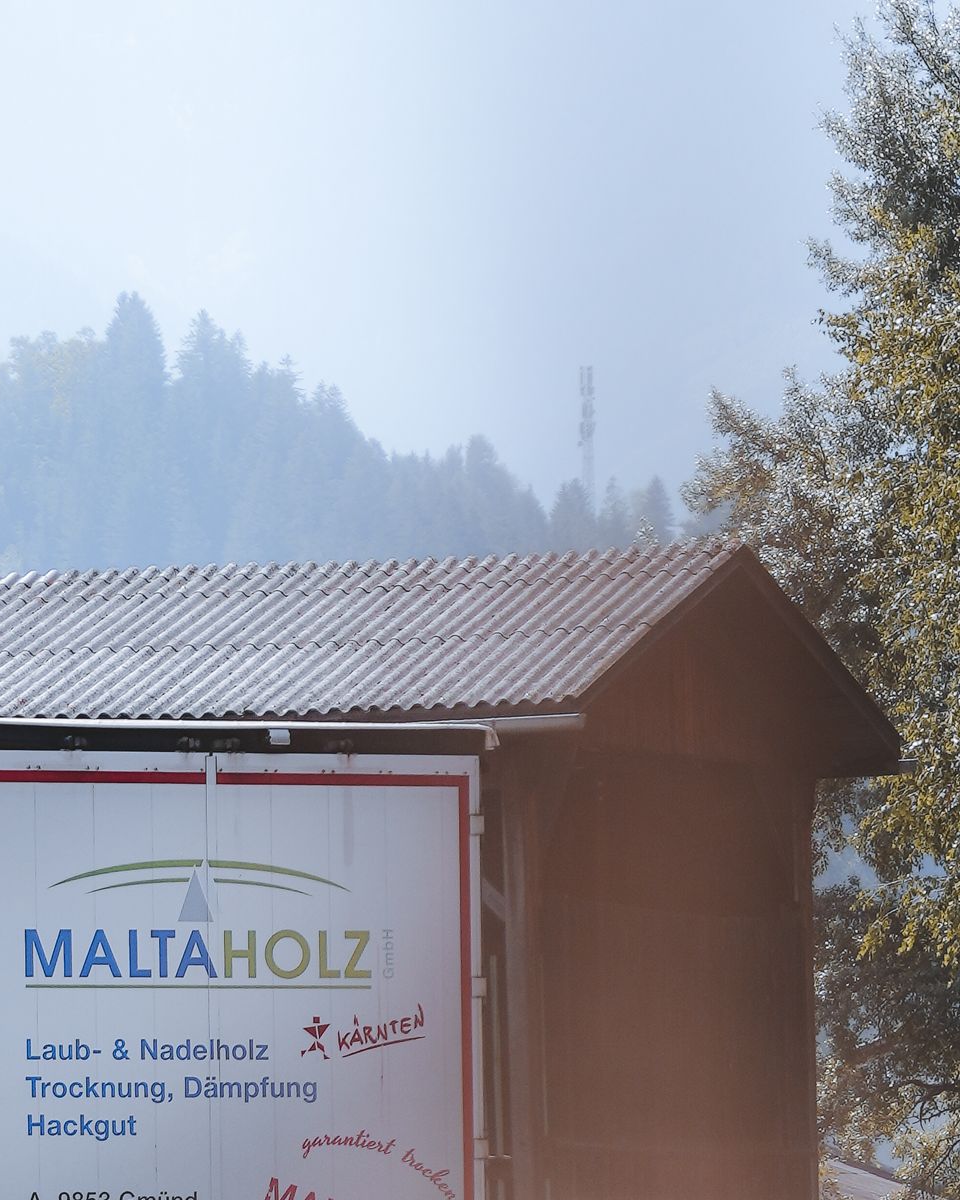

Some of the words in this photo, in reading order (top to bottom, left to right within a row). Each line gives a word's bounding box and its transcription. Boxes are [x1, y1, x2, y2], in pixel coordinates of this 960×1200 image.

[24, 928, 373, 980] MALTAHOLZ
[382, 928, 395, 979] GmbH
[338, 1003, 425, 1051] KÄRNTEN
[26, 1039, 102, 1061] Laub-
[112, 1039, 130, 1061] &
[140, 1039, 270, 1062] Nadelholz
[25, 1076, 174, 1103] Trocknung,
[184, 1077, 319, 1103] Dämpfung
[27, 1114, 138, 1141] Hackgut
[302, 1129, 396, 1159] garantiert
